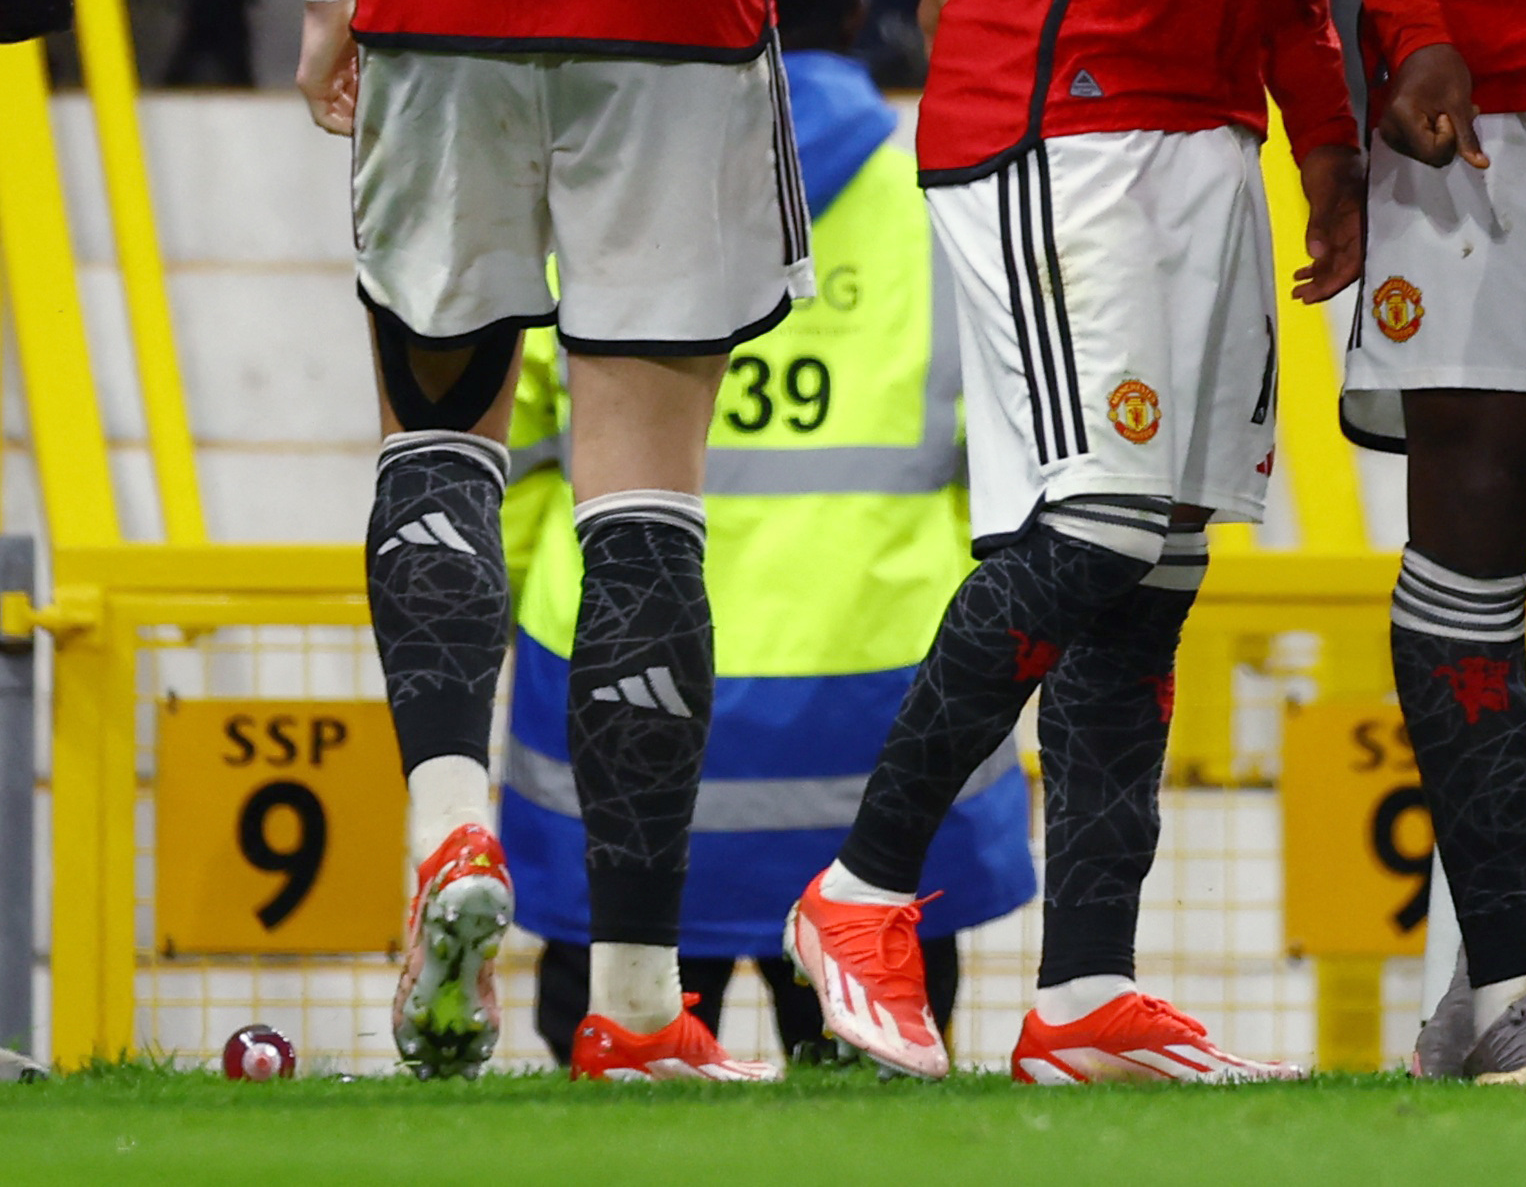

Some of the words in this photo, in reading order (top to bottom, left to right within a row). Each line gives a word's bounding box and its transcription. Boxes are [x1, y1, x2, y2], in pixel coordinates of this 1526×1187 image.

[724, 355, 832, 433] 39
[222, 715, 348, 768] SSP
[237, 780, 329, 932] 9
[1369, 784, 1434, 931] 9
